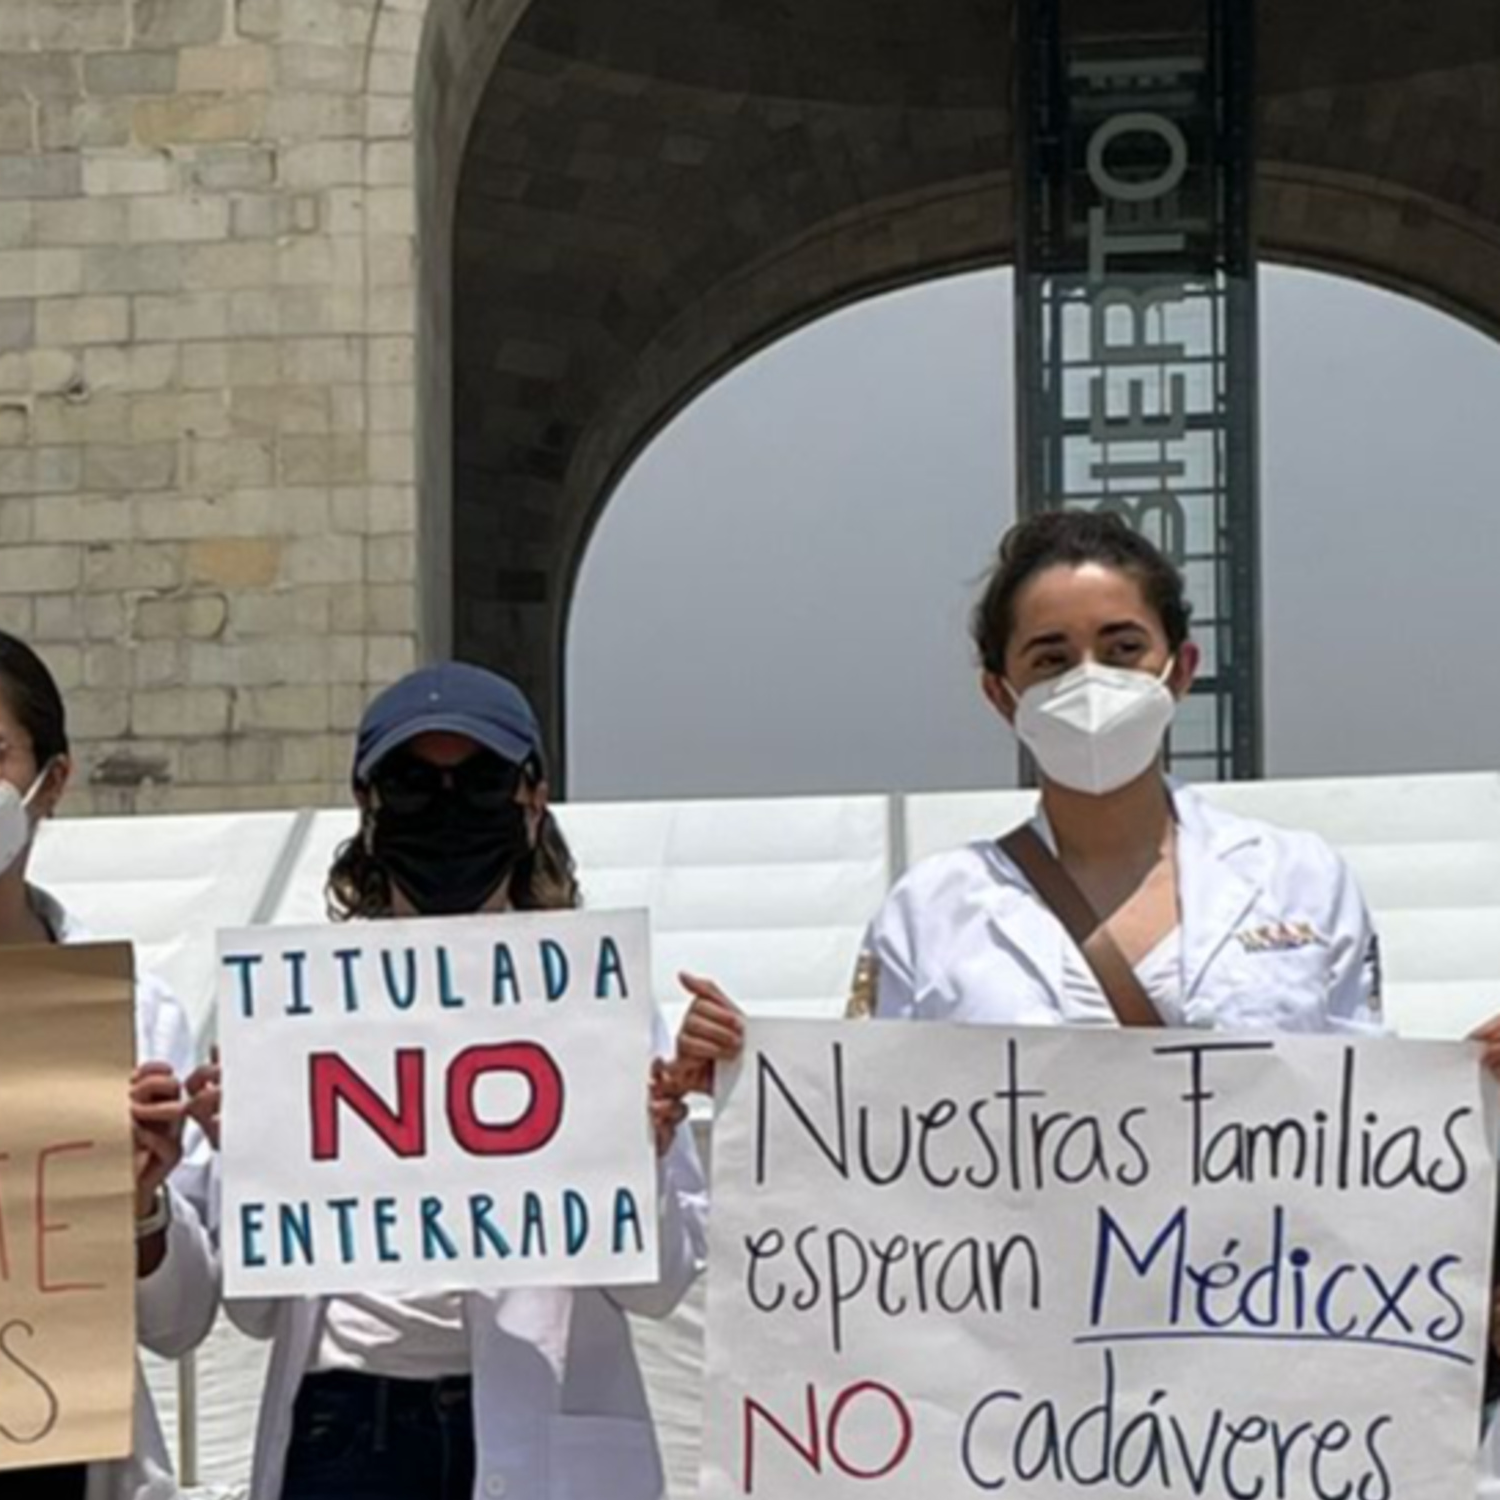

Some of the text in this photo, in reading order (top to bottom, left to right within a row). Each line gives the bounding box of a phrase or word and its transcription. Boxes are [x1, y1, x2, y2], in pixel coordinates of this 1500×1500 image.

[222, 935, 629, 1018] TITULADA
[307, 1040, 566, 1162] NO
[755, 1038, 1150, 1191] Nuestras
[240, 1187, 645, 1268] ENTERRADA
[745, 1204, 1465, 1354] esperan Médicxs
[742, 1379, 913, 1495] NO
